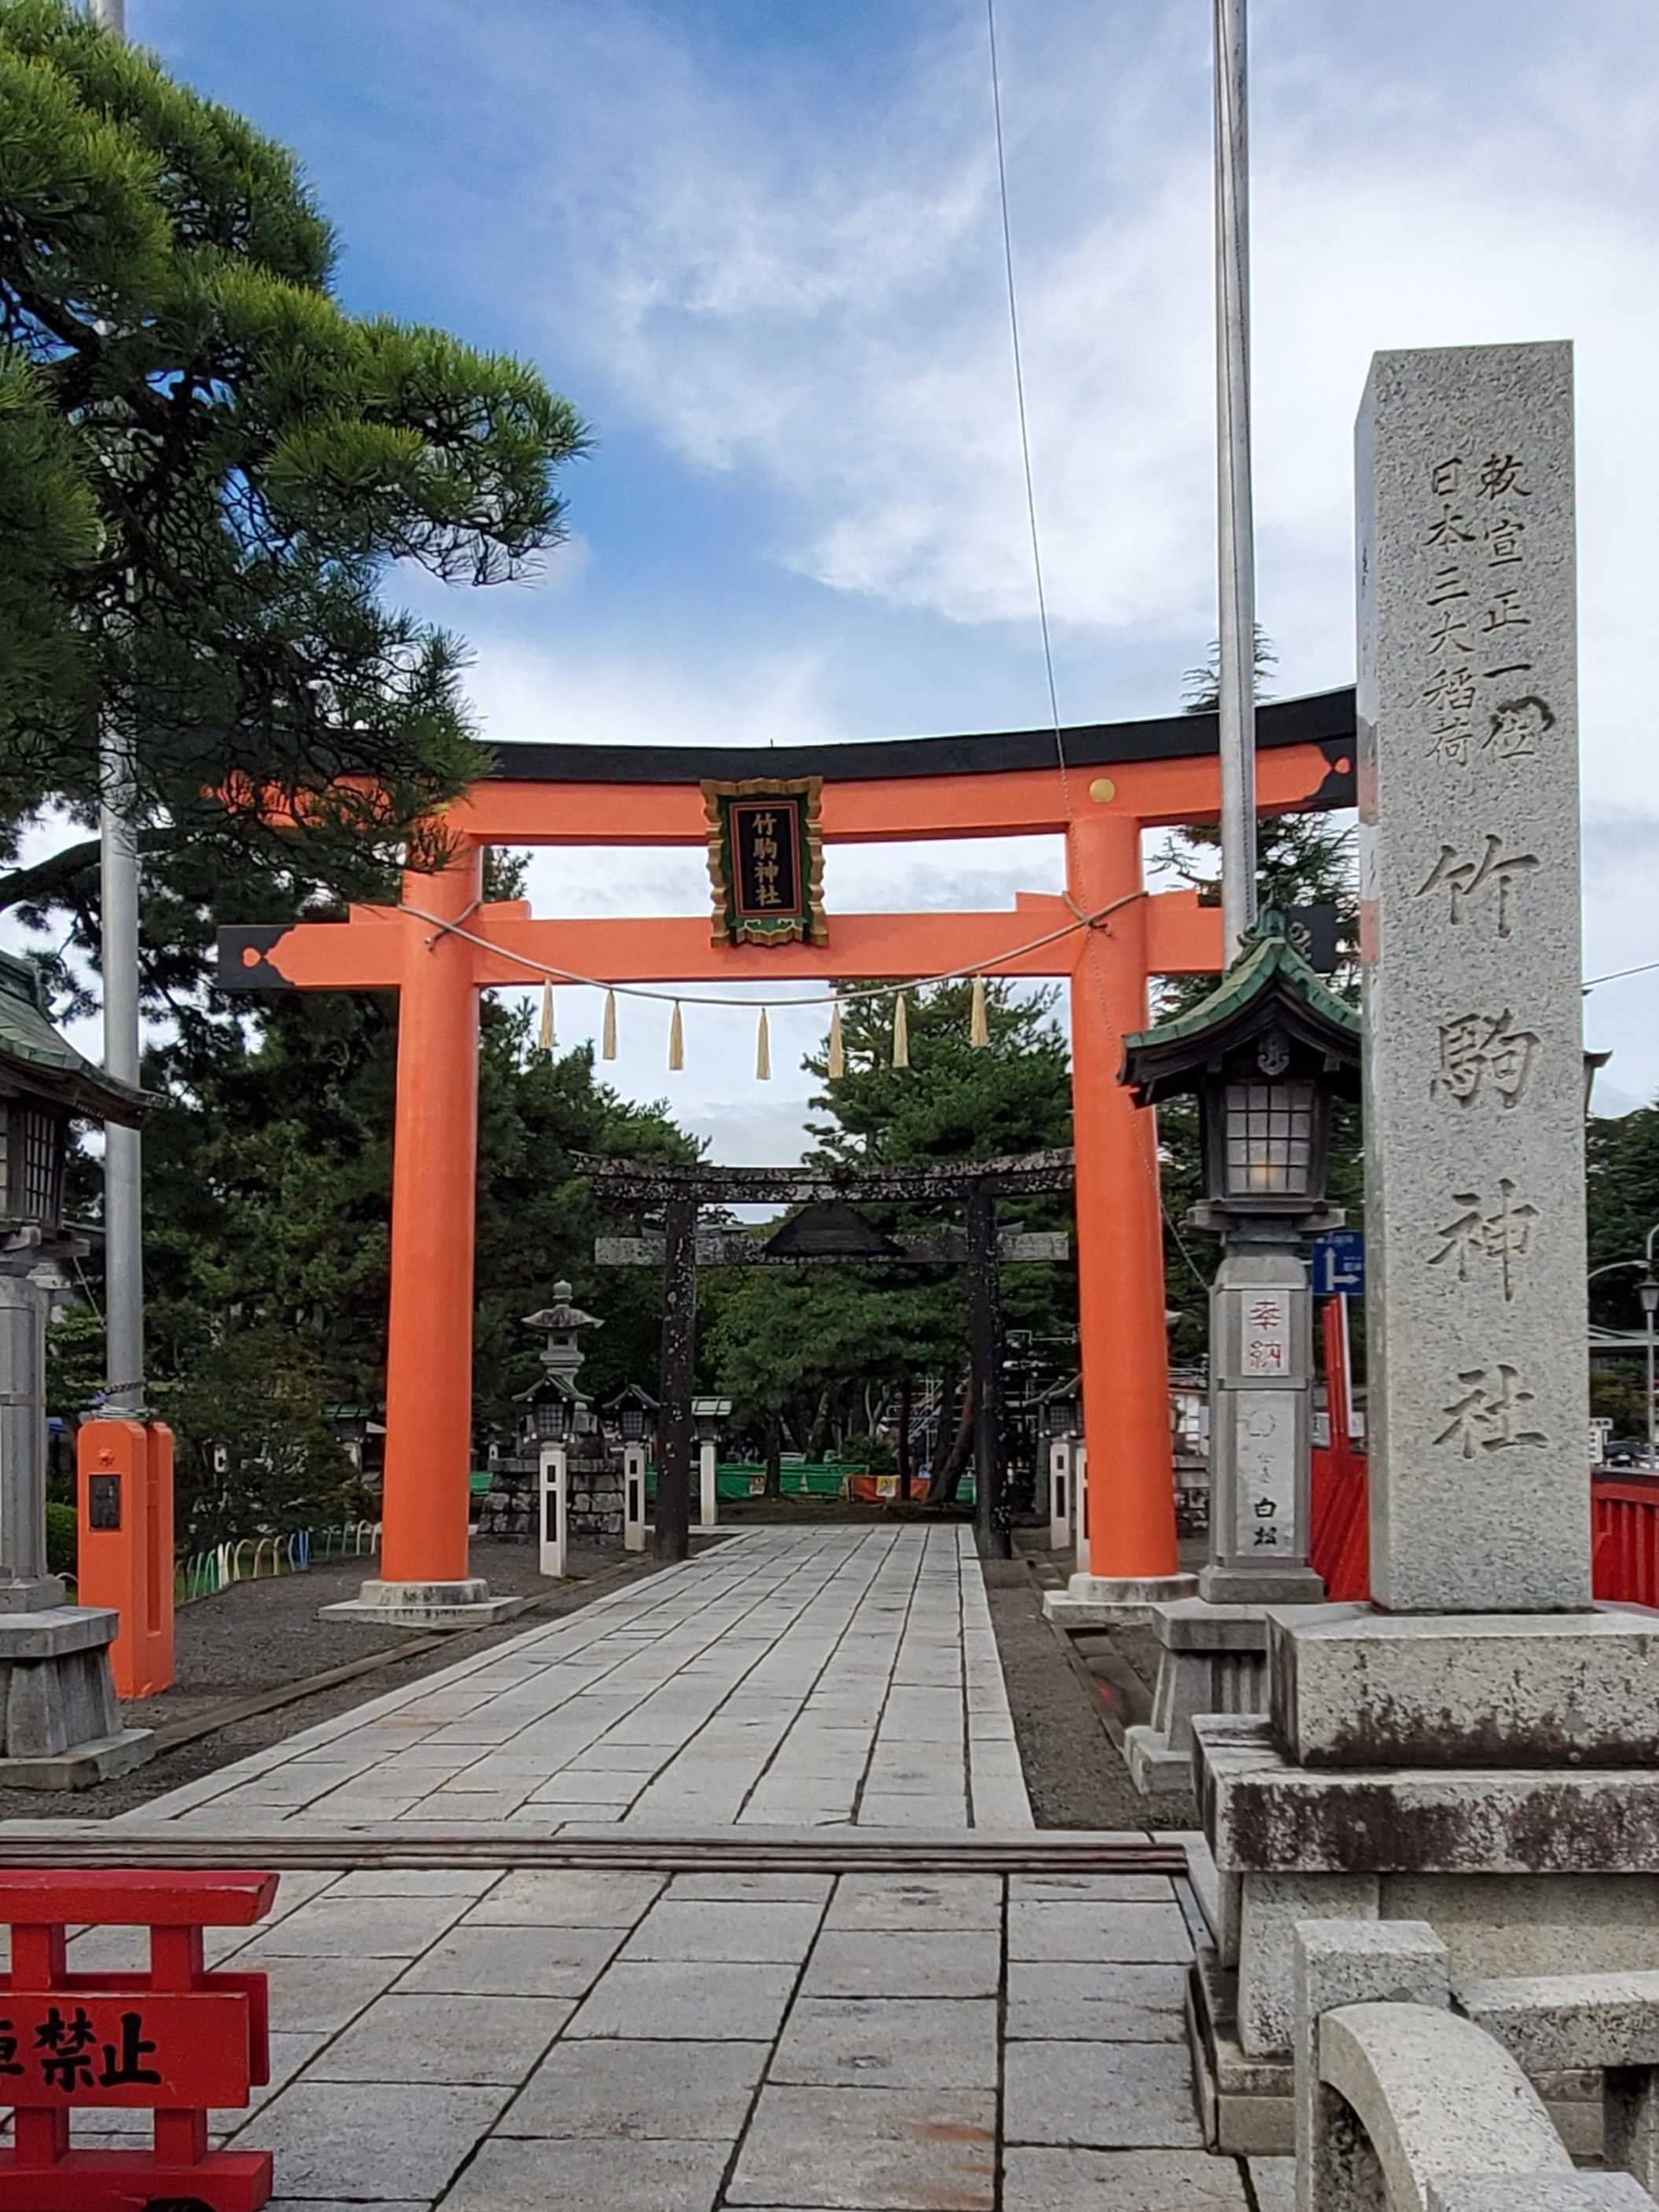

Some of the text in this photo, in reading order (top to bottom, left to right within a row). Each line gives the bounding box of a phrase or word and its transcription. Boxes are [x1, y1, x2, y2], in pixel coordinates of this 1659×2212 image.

[752, 812, 782, 907] 竹駒神社
[1416, 834, 1549, 1459] 竹駒神社
[1249, 1299, 1282, 1368] 奉納
